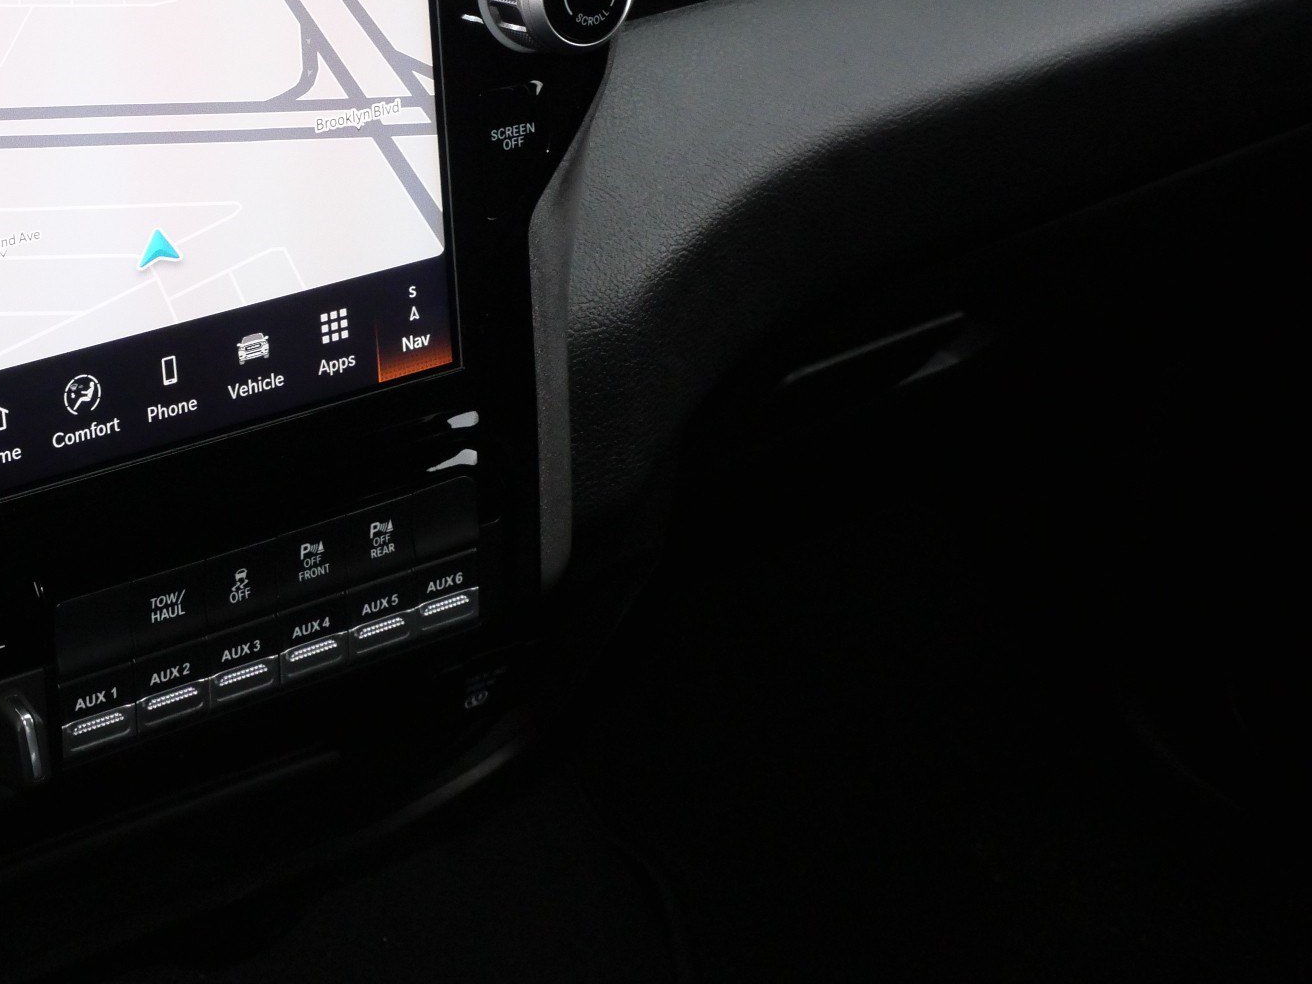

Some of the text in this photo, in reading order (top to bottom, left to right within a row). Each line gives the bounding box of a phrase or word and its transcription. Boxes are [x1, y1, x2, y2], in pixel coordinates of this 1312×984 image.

[575, 9, 610, 27] SCROLL
[315, 99, 401, 133] Brooklyn Blvd
[491, 122, 536, 141] SCREEN
[503, 136, 525, 151] OFF
[18, 229, 41, 245] Ave
[408, 285, 417, 298] S
[401, 333, 431, 352] Nav
[318, 354, 356, 377] Apps
[227, 373, 285, 400] Vehicle
[147, 398, 198, 423] Phone
[52, 417, 121, 449] Comfort
[372, 533, 392, 547] OFF
[303, 553, 323, 568] OFF
[370, 542, 396, 559] REAR
[298, 563, 330, 582] FRONT
[426, 571, 464, 594] AUX 6
[150, 589, 186, 610] TOW/
[229, 586, 252, 604] OFF
[361, 593, 399, 616] AUX 5
[151, 604, 186, 623] HAUL
[292, 616, 331, 639] AUX 4
[221, 639, 262, 662] AUX 3
[149, 662, 191, 686] AUX 2
[75, 686, 118, 712] AUX 1
